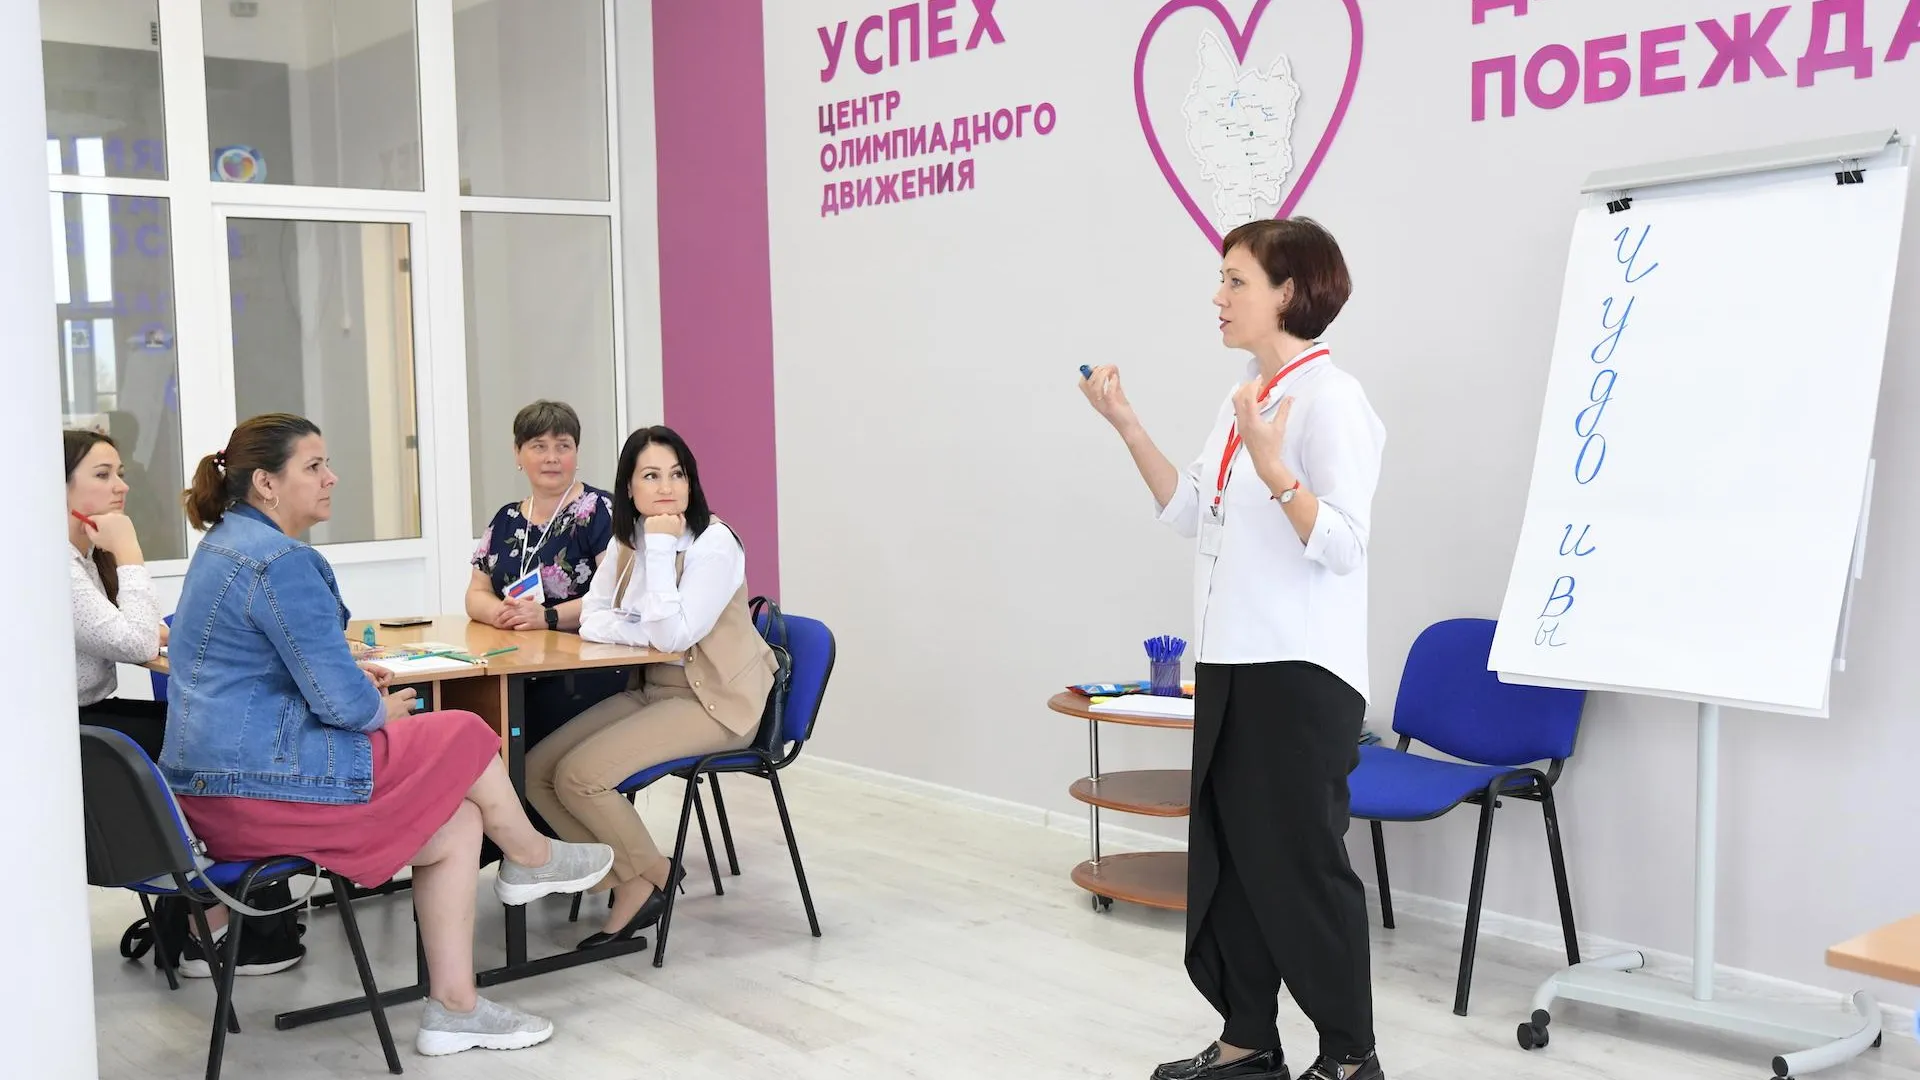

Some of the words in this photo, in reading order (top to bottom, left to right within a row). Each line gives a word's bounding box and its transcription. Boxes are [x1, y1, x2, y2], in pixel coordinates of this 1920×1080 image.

[817, 0, 1006, 84] УСПЕХ
[818, 90, 901, 136] ЦЕНТР
[820, 102, 1057, 173] ОЛИМПИАДНОГО
[821, 158, 975, 217] ДВИЖЕНИЯ
